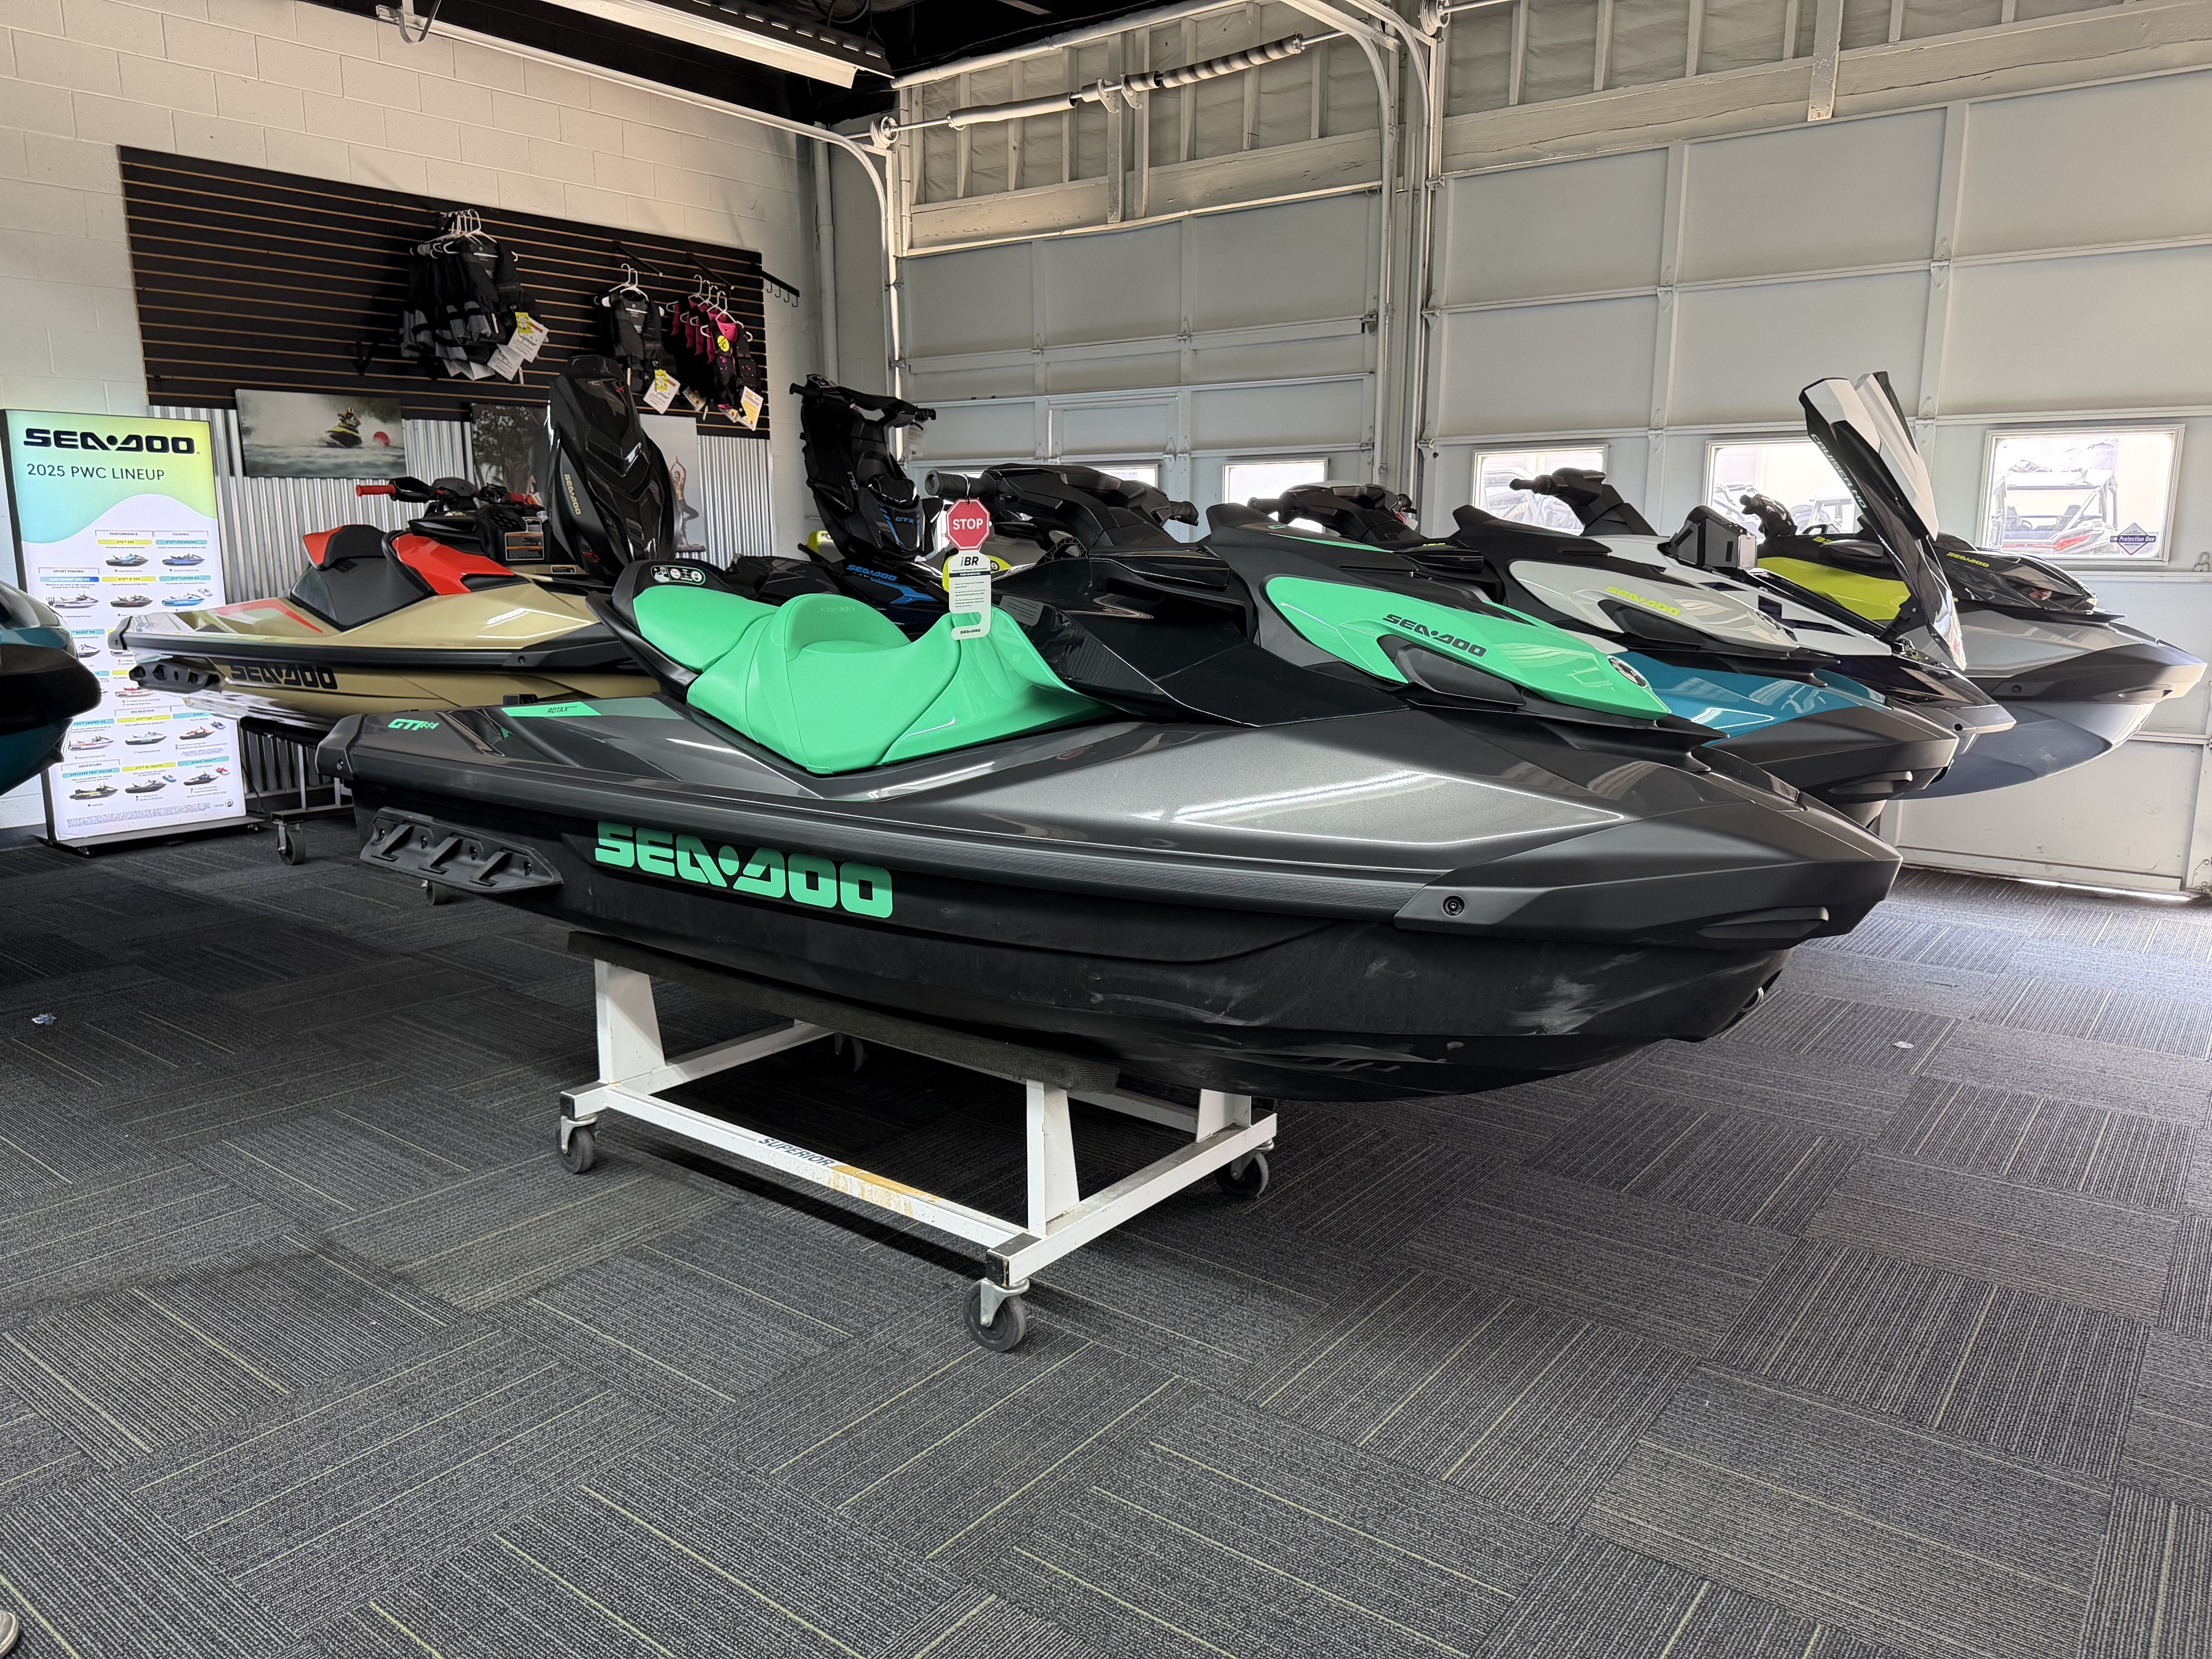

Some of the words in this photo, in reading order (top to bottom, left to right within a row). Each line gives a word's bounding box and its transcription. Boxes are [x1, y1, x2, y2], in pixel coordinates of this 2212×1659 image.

[1811, 434, 1853, 486] CRUISER
[27, 464, 65, 477] 2025
[71, 466, 107, 479] PWC
[112, 467, 165, 481] LINEUP
[953, 519, 983, 530] STOP
[960, 556, 979, 566] iBR
[388, 718, 425, 731] GTI
[758, 1138, 835, 1166] SUPERIOR
